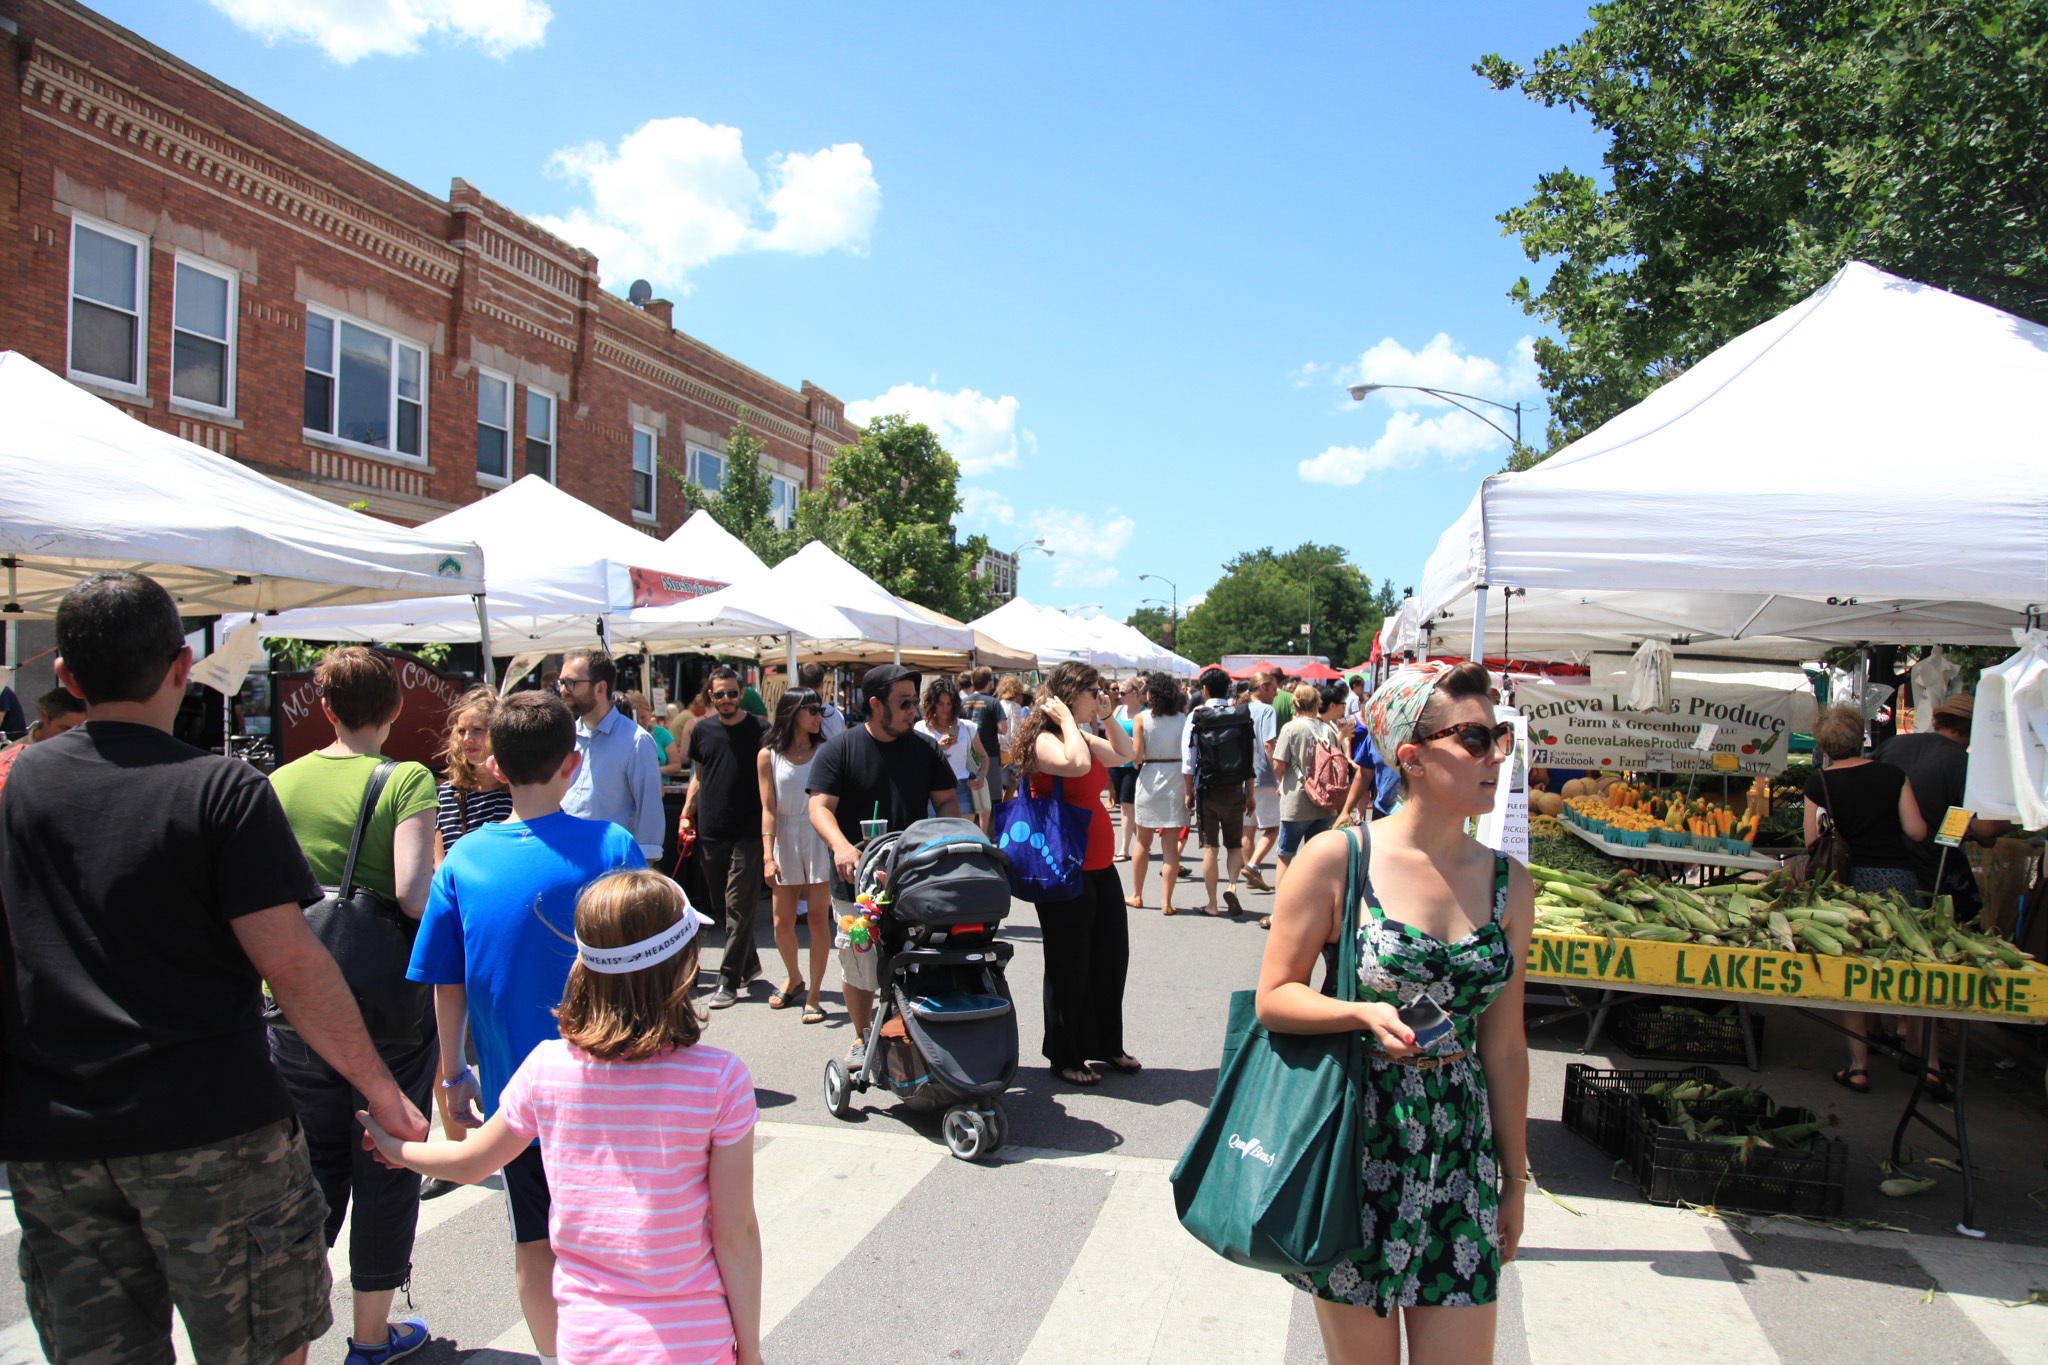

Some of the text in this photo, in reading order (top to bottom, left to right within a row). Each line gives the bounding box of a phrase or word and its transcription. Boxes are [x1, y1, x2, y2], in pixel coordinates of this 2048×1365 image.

[1519, 697, 1604, 722] Geneva
[1688, 696, 1786, 733] Produce
[1568, 716, 1607, 729] Farm
[1611, 719, 1622, 729] &
[1625, 719, 1701, 734] Greenhou
[1549, 756, 1595, 766] Facebook
[1676, 950, 1804, 993] LAKES
[1844, 963, 2031, 1013] PRODUCE
